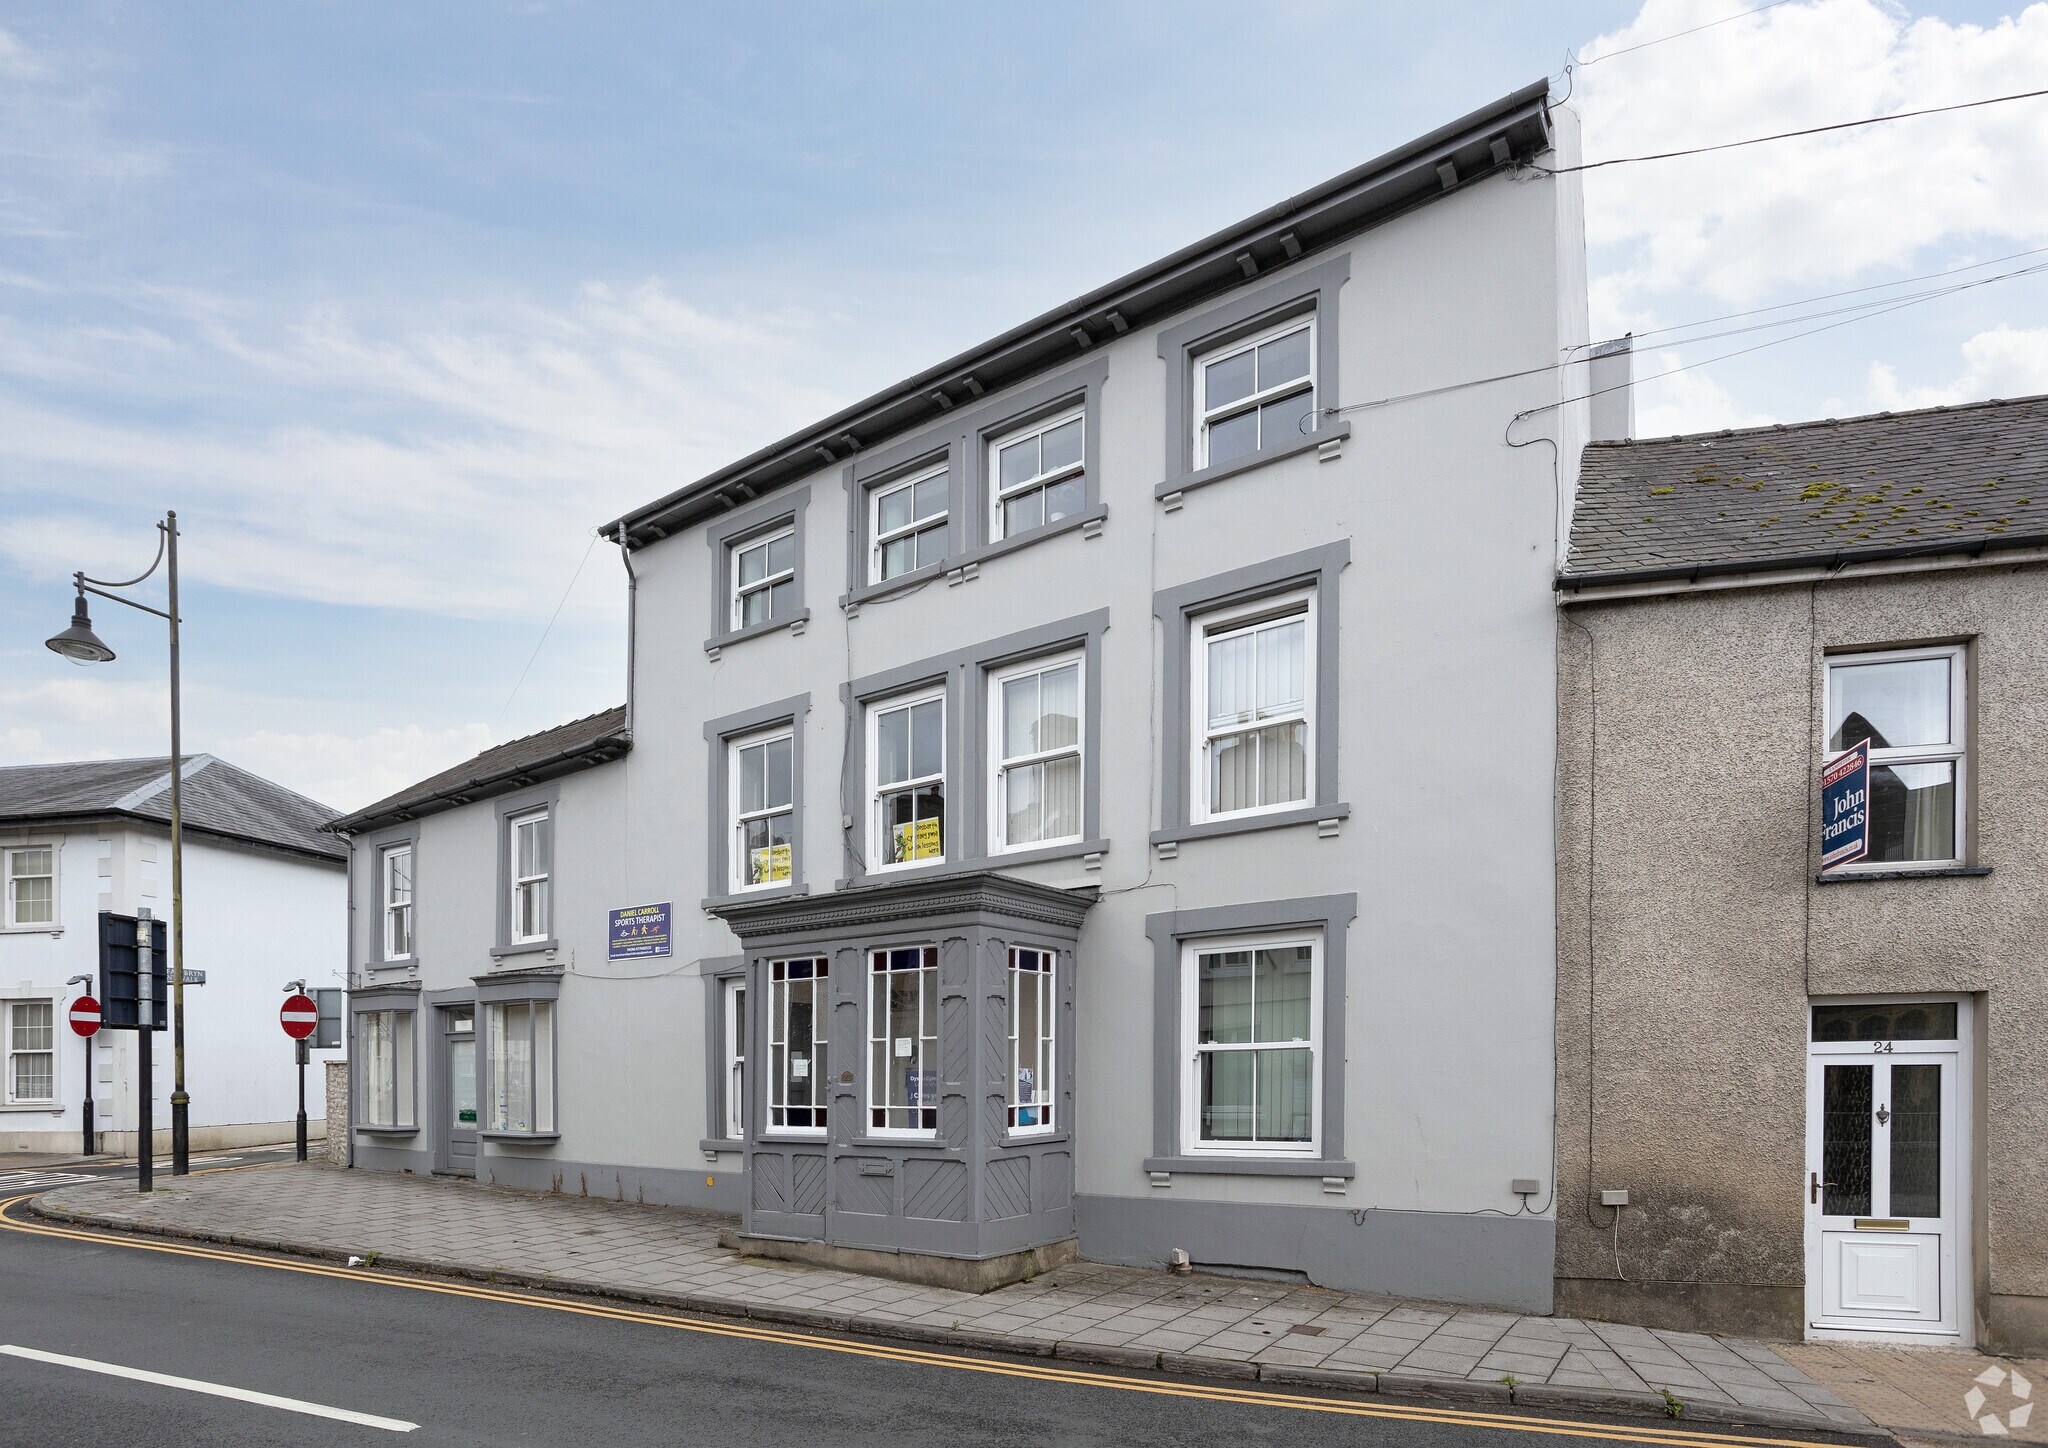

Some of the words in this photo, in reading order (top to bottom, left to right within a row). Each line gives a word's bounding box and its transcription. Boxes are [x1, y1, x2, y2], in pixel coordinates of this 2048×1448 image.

[1823, 772, 1838, 786] 1570
[1833, 788, 1864, 821] John
[620, 910, 638, 918] DANIEL
[638, 907, 659, 915] CARROLL
[615, 918, 635, 927] SPORTS
[636, 914, 665, 924] THERAPIST
[1874, 1041, 1893, 1053] 24
